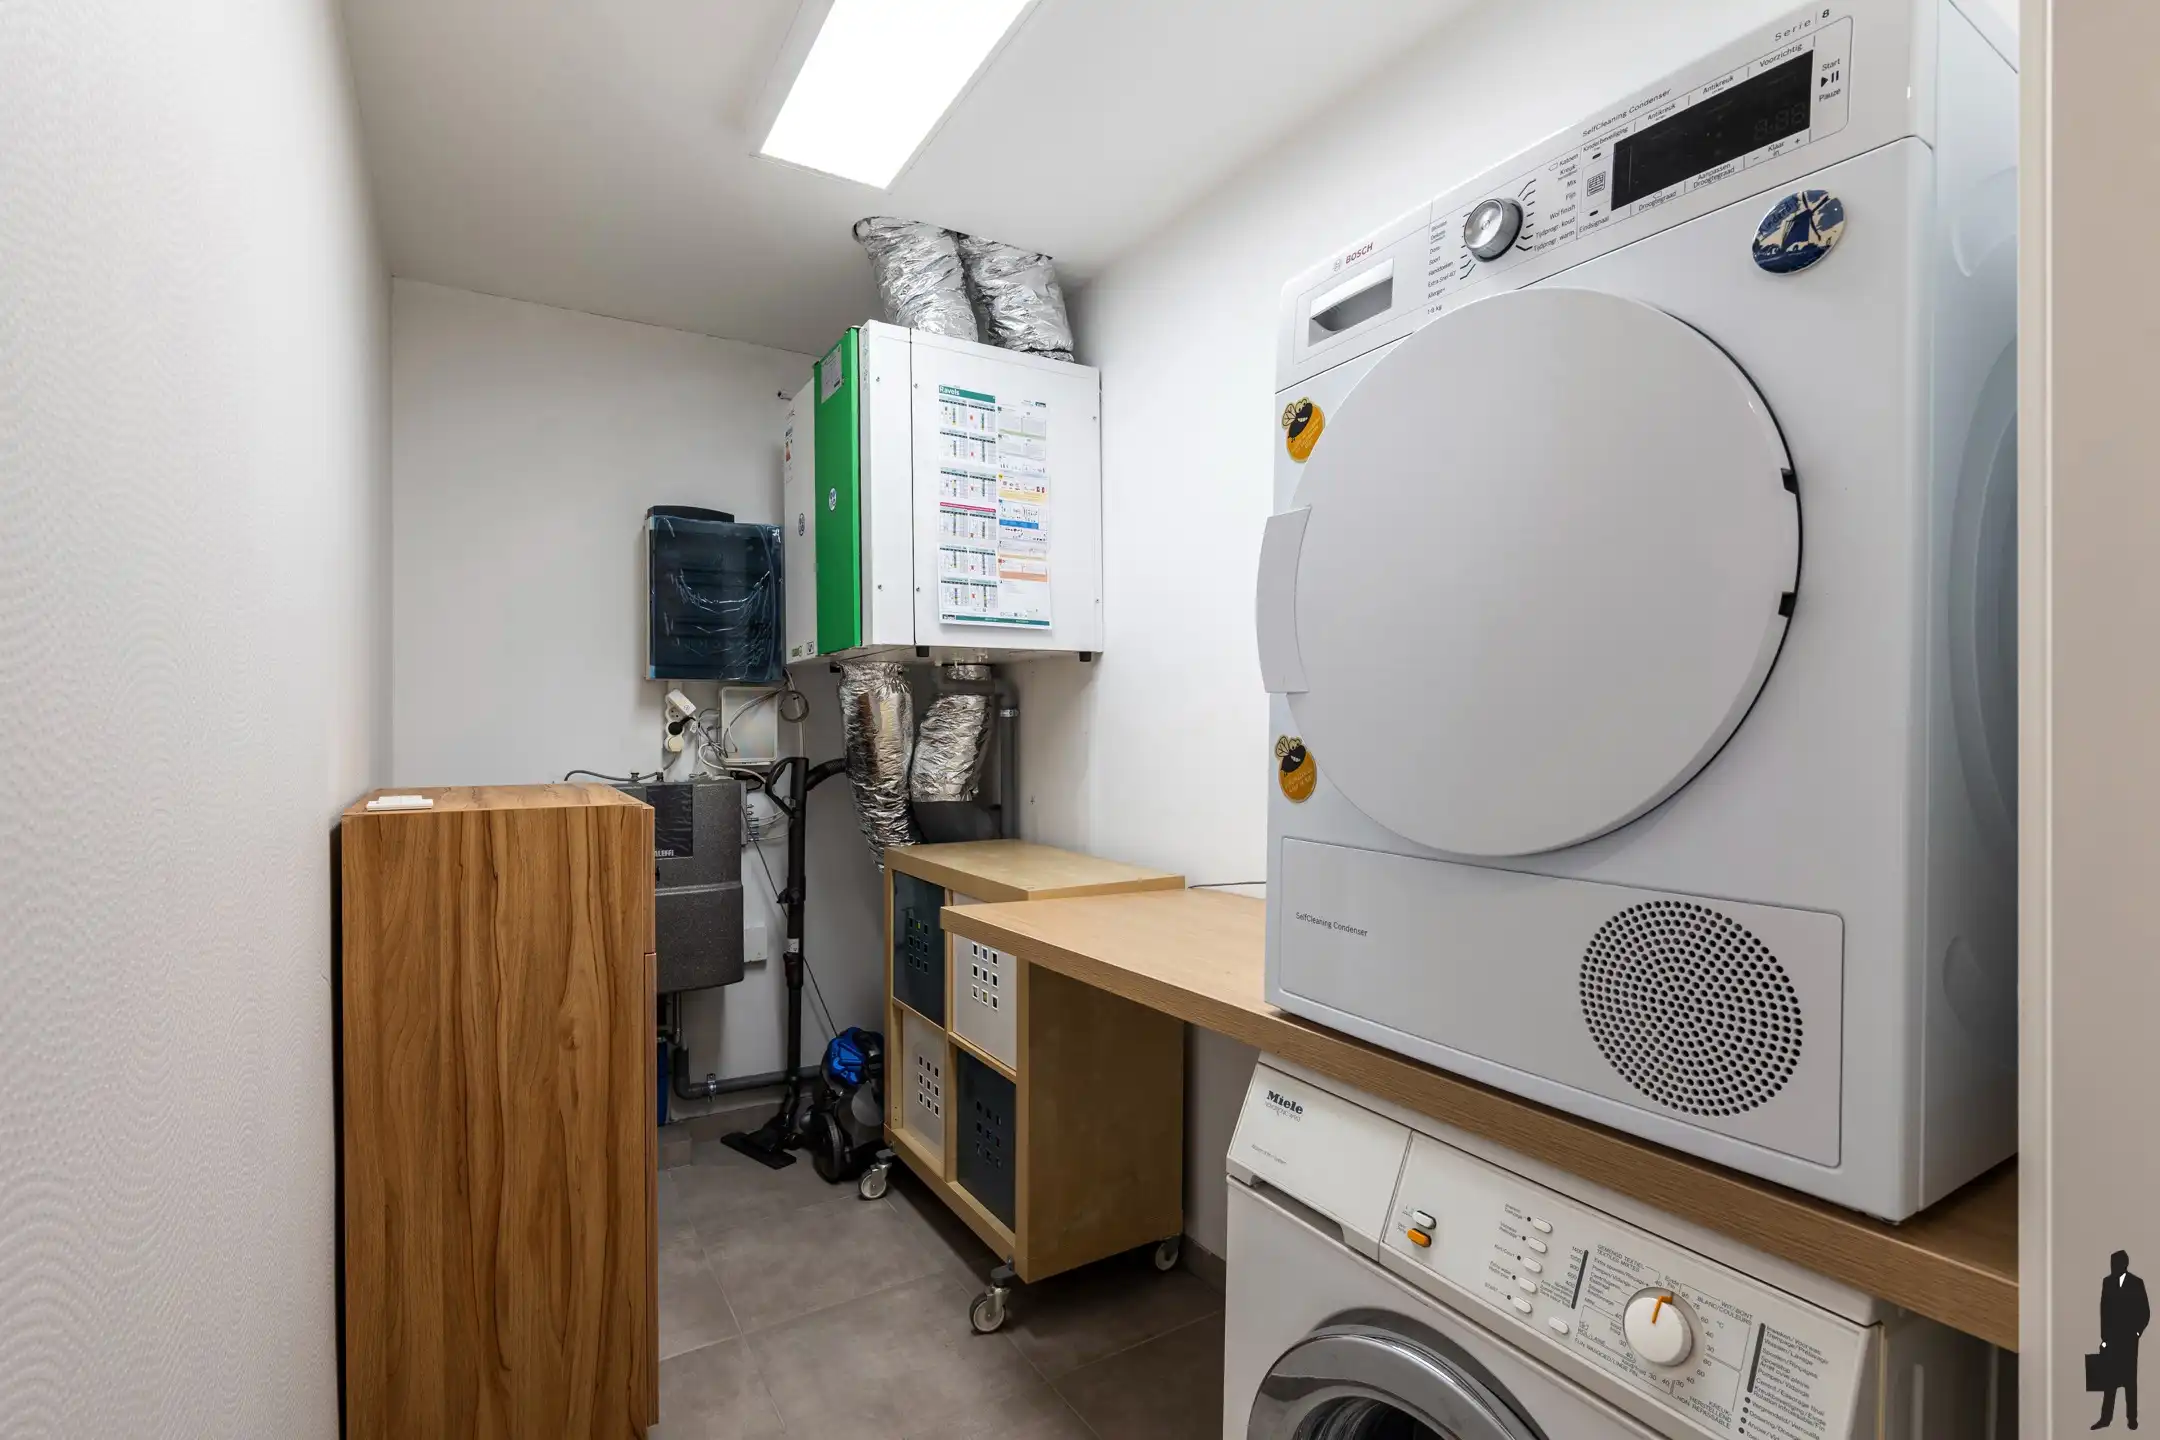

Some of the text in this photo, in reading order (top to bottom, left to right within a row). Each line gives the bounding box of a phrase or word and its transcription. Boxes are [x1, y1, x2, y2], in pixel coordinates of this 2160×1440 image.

[1774, 9, 1830, 41] Serie 8
[1759, 43, 1803, 68] Voorzichtig
[1821, 58, 1840, 71] Start
[1703, 75, 1734, 95] Antikreuk
[1819, 88, 1841, 102] Pauze
[1582, 88, 1672, 138] SelfCleaning Condenser
[1647, 102, 1676, 121] Antikreuk
[1767, 141, 1785, 152] Klaar
[1559, 153, 1579, 166] Katoen
[1693, 166, 1735, 189] Droogtegraad
[1697, 162, 1731, 181] Aanpassen
[1566, 180, 1577, 188] Mix
[1638, 190, 1678, 212] Droogtegraad
[1549, 211, 1560, 220] Wol
[1561, 216, 1576, 227] koud
[1579, 216, 1610, 233] Eindsignaal
[1559, 230, 1575, 240] warm
[1345, 242, 1374, 264] BOSCH
[1427, 279, 1439, 288] Extra
[1295, 911, 1368, 937] SelfCleaning Condenser
[1266, 1090, 1304, 1115] Miele
[1572, 1246, 1584, 1255] 1400
[1654, 1279, 1663, 1288] 40
[1664, 1275, 1680, 1287] Einde
[1681, 1291, 1690, 1300] 95
[1692, 1302, 1701, 1311] 75
[1696, 1295, 1753, 1326] BLANC/COULEURS
[1700, 1316, 1709, 1325] 60
[1705, 1330, 1715, 1339] 40
[1706, 1344, 1715, 1353] 30
[1648, 1373, 1657, 1381] 30
[1686, 1376, 1695, 1385] 40
[1661, 1379, 1670, 1388] 40
[1675, 1380, 1685, 1388] 30
[1676, 1395, 1731, 1430] NON REPASSABLE
[1689, 1395, 1732, 1423] HERSTELLEND
